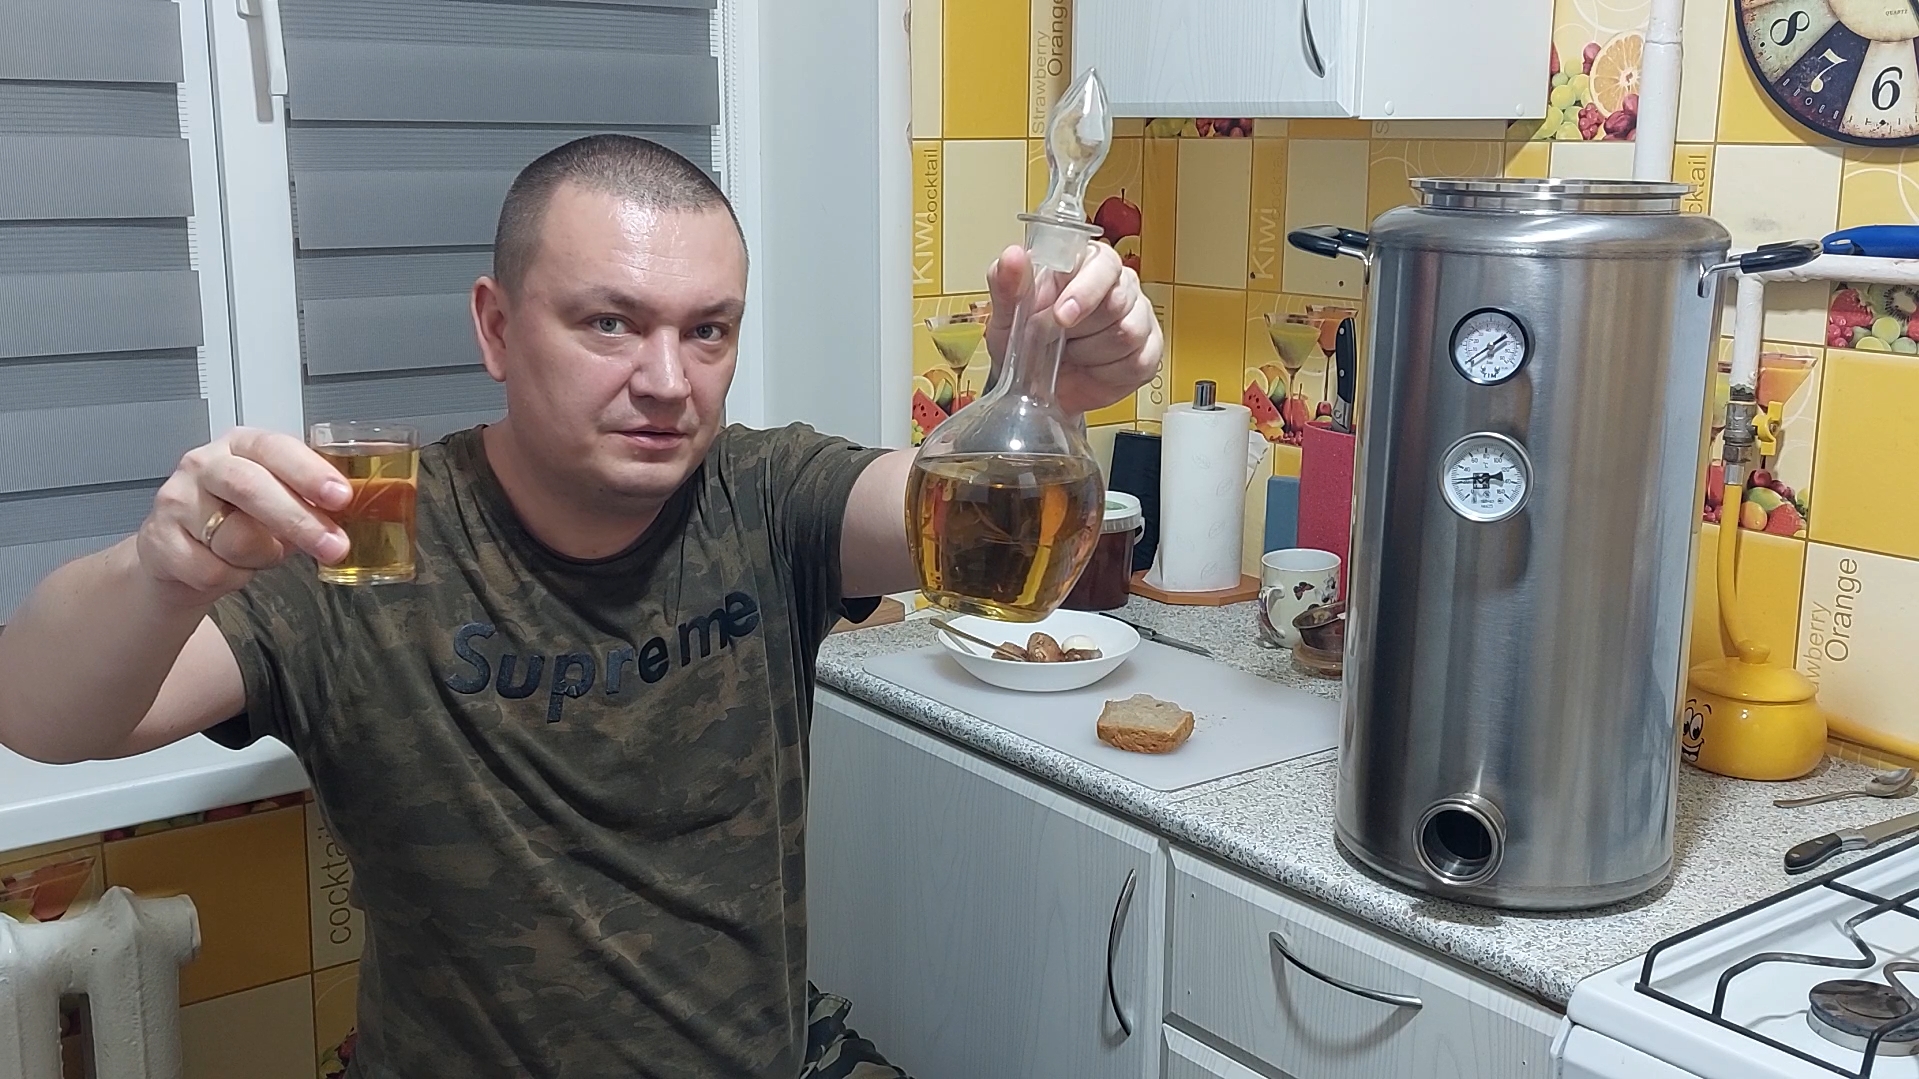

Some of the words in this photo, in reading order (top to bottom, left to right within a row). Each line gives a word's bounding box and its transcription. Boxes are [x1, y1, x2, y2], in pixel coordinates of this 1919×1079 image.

[1047, 0, 1068, 76] Orang
[1769, 10, 1810, 46] 8
[1032, 30, 1051, 134] Strawberry
[1811, 48, 1848, 93] 7
[1871, 66, 1903, 111] 6
[923, 149, 938, 223] cocktail
[1252, 207, 1277, 280] Kiwi
[1803, 601, 1832, 694] wberry
[1824, 558, 1862, 662] Orange
[445, 591, 761, 724] Supreme
